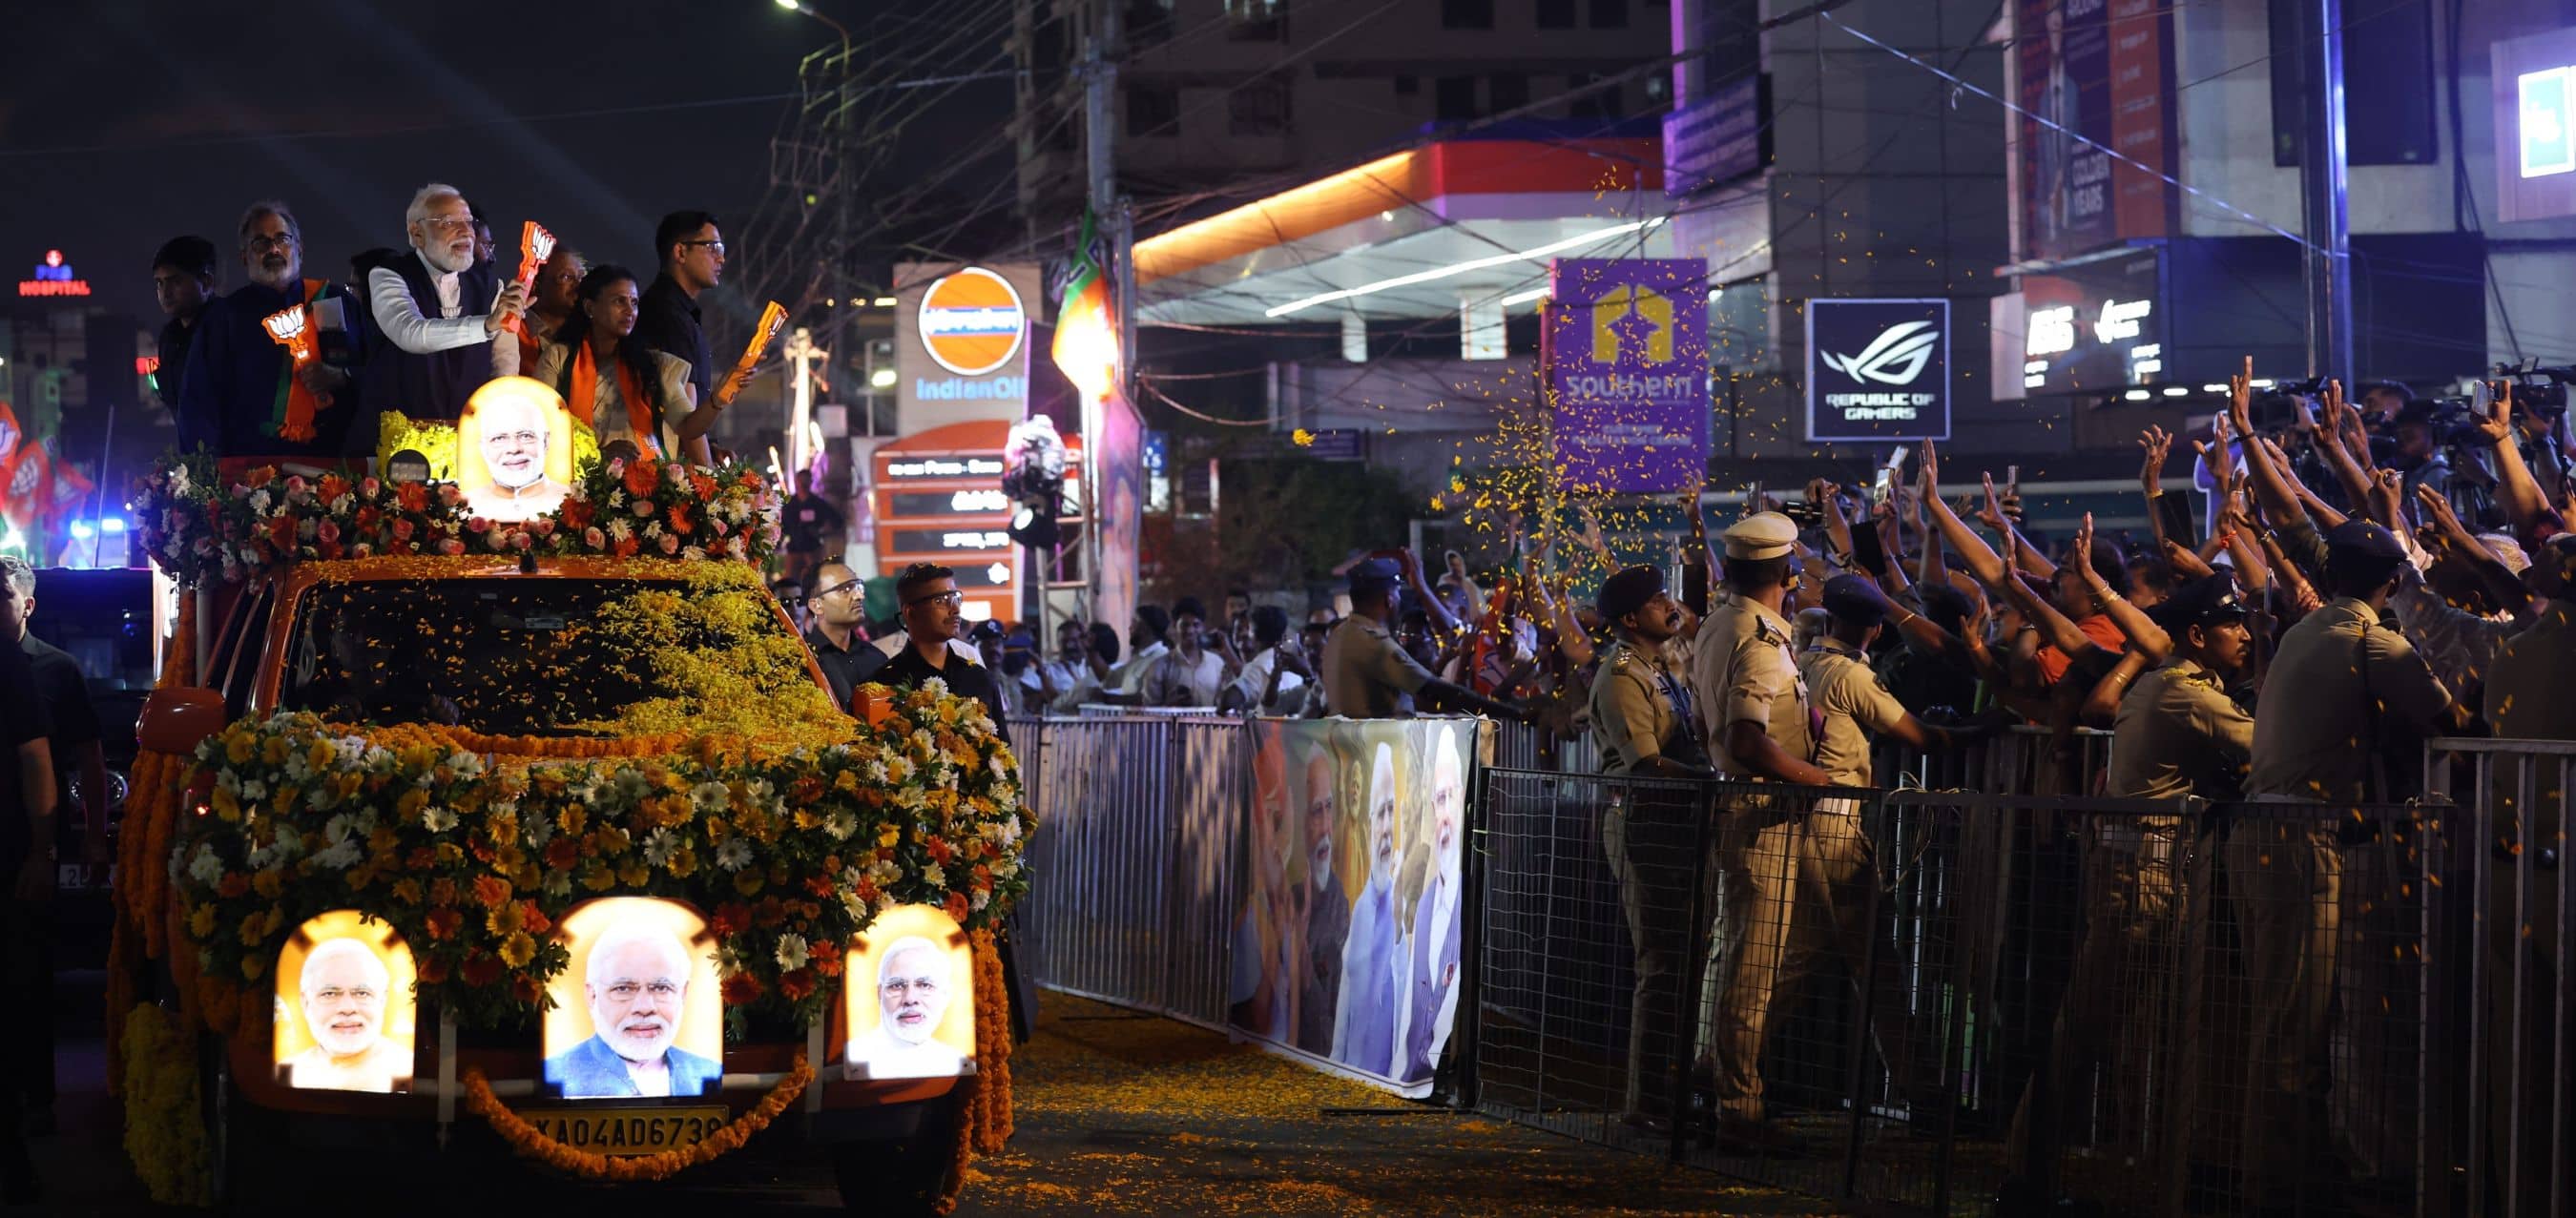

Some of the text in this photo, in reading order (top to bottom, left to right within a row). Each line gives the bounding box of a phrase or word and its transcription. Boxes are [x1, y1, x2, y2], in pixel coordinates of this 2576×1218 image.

[19, 279, 91, 297] HOSPITAL
[917, 377, 1028, 400] IndianOil
[1567, 373, 1693, 399] southern
[1825, 393, 1935, 409] REPUBLIC OF
[1844, 406, 1917, 420] GAMERS
